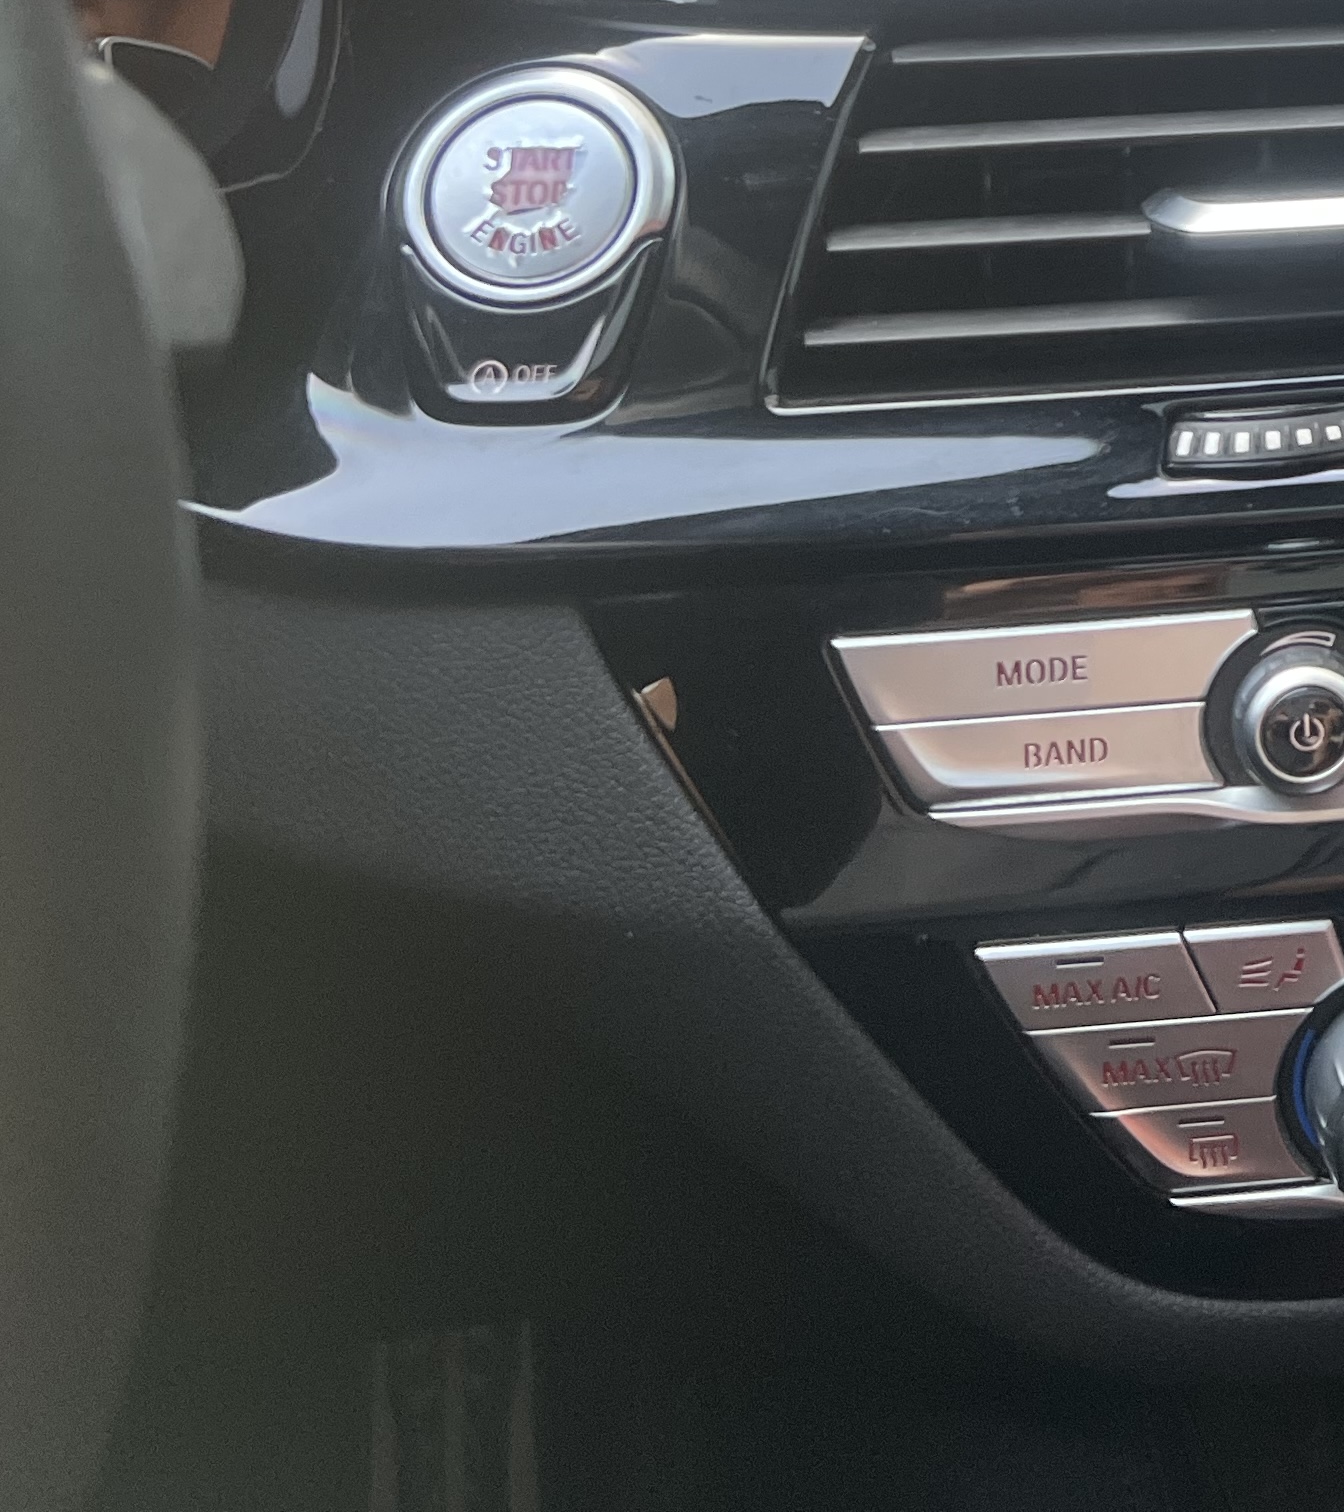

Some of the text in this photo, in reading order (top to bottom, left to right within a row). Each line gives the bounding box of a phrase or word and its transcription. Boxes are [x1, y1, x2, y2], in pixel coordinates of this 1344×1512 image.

[482, 143, 582, 172] START
[490, 178, 570, 209] STOP
[470, 218, 581, 256] ENGINE
[512, 364, 558, 384] OFF
[995, 654, 1089, 687] MODE
[1023, 736, 1110, 770] BAND
[1032, 973, 1162, 1010] MAX A/C
[1101, 1058, 1173, 1088] MAX
